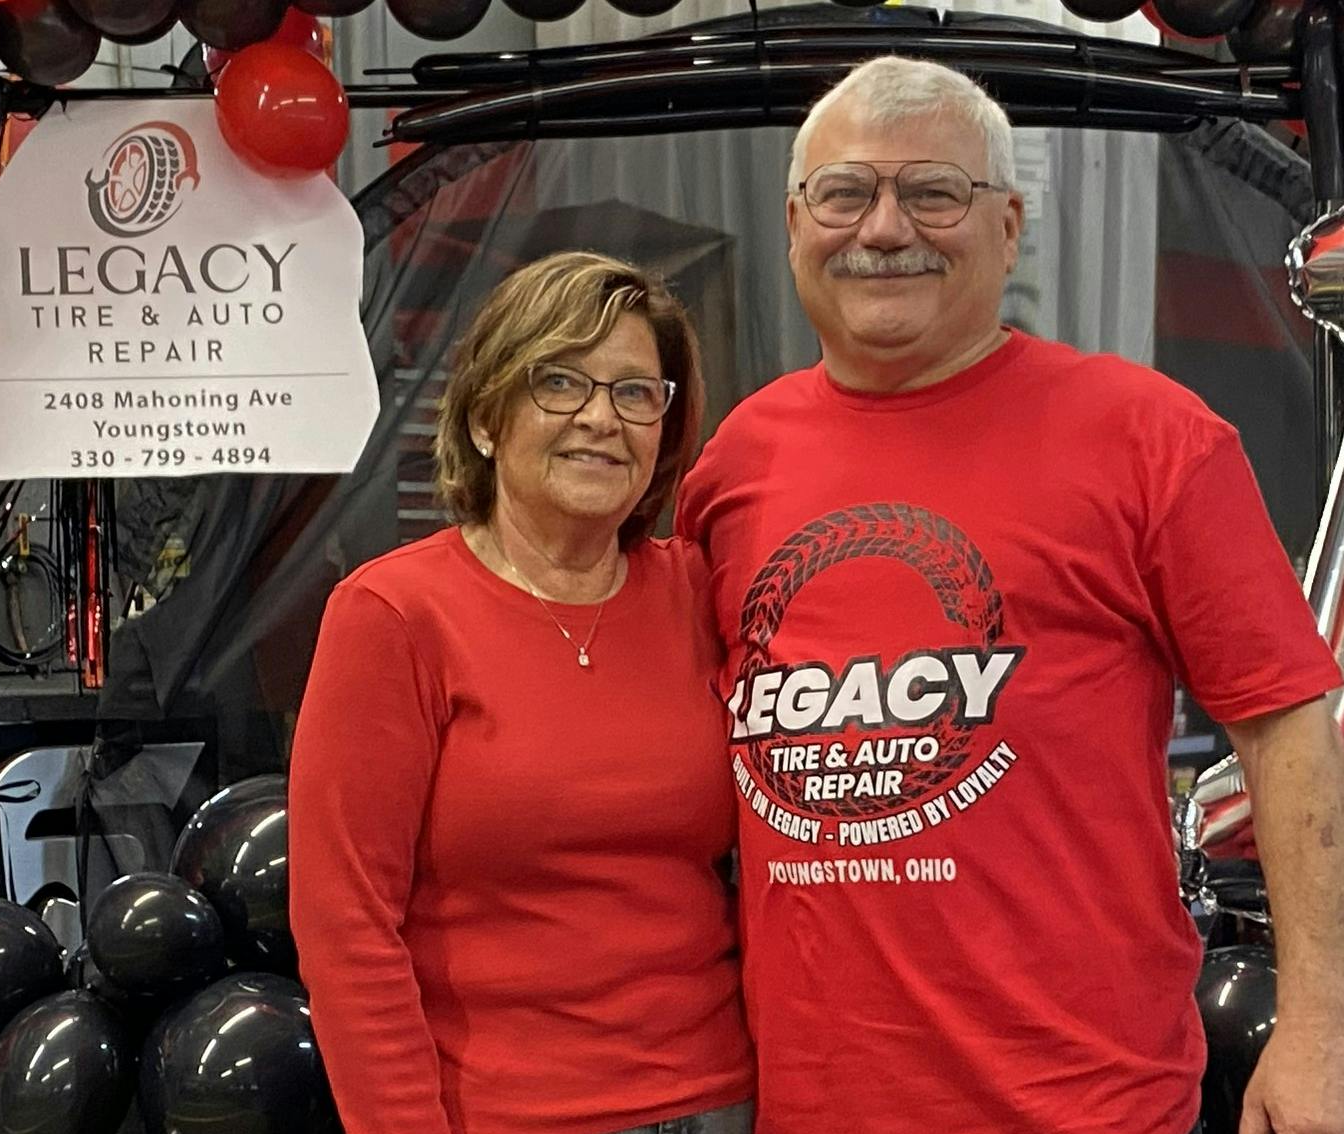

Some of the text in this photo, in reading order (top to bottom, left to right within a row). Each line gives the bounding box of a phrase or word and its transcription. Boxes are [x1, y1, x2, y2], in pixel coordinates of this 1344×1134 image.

[19, 242, 298, 297] LEGACY
[31, 302, 284, 329] TIRE & AUTO
[88, 339, 225, 364] REPAIR
[43, 389, 293, 412] 2408 Mahoning Ave
[93, 420, 246, 442] Youngstown
[70, 450, 115, 468] 330
[141, 449, 186, 467] 799
[211, 446, 272, 465] 4894
[727, 651, 1017, 740] LEGACY
[769, 735, 940, 774] TIRE & AUTO
[732, 752, 757, 800] BUILT
[751, 787, 770, 819] ON
[767, 807, 822, 845] LEGACY
[839, 810, 923, 847] POWERED
[925, 797, 952, 827] BY
[952, 740, 1019, 812] LOYALTY
[803, 769, 905, 801] REPAIR
[905, 857, 956, 882] OHIO
